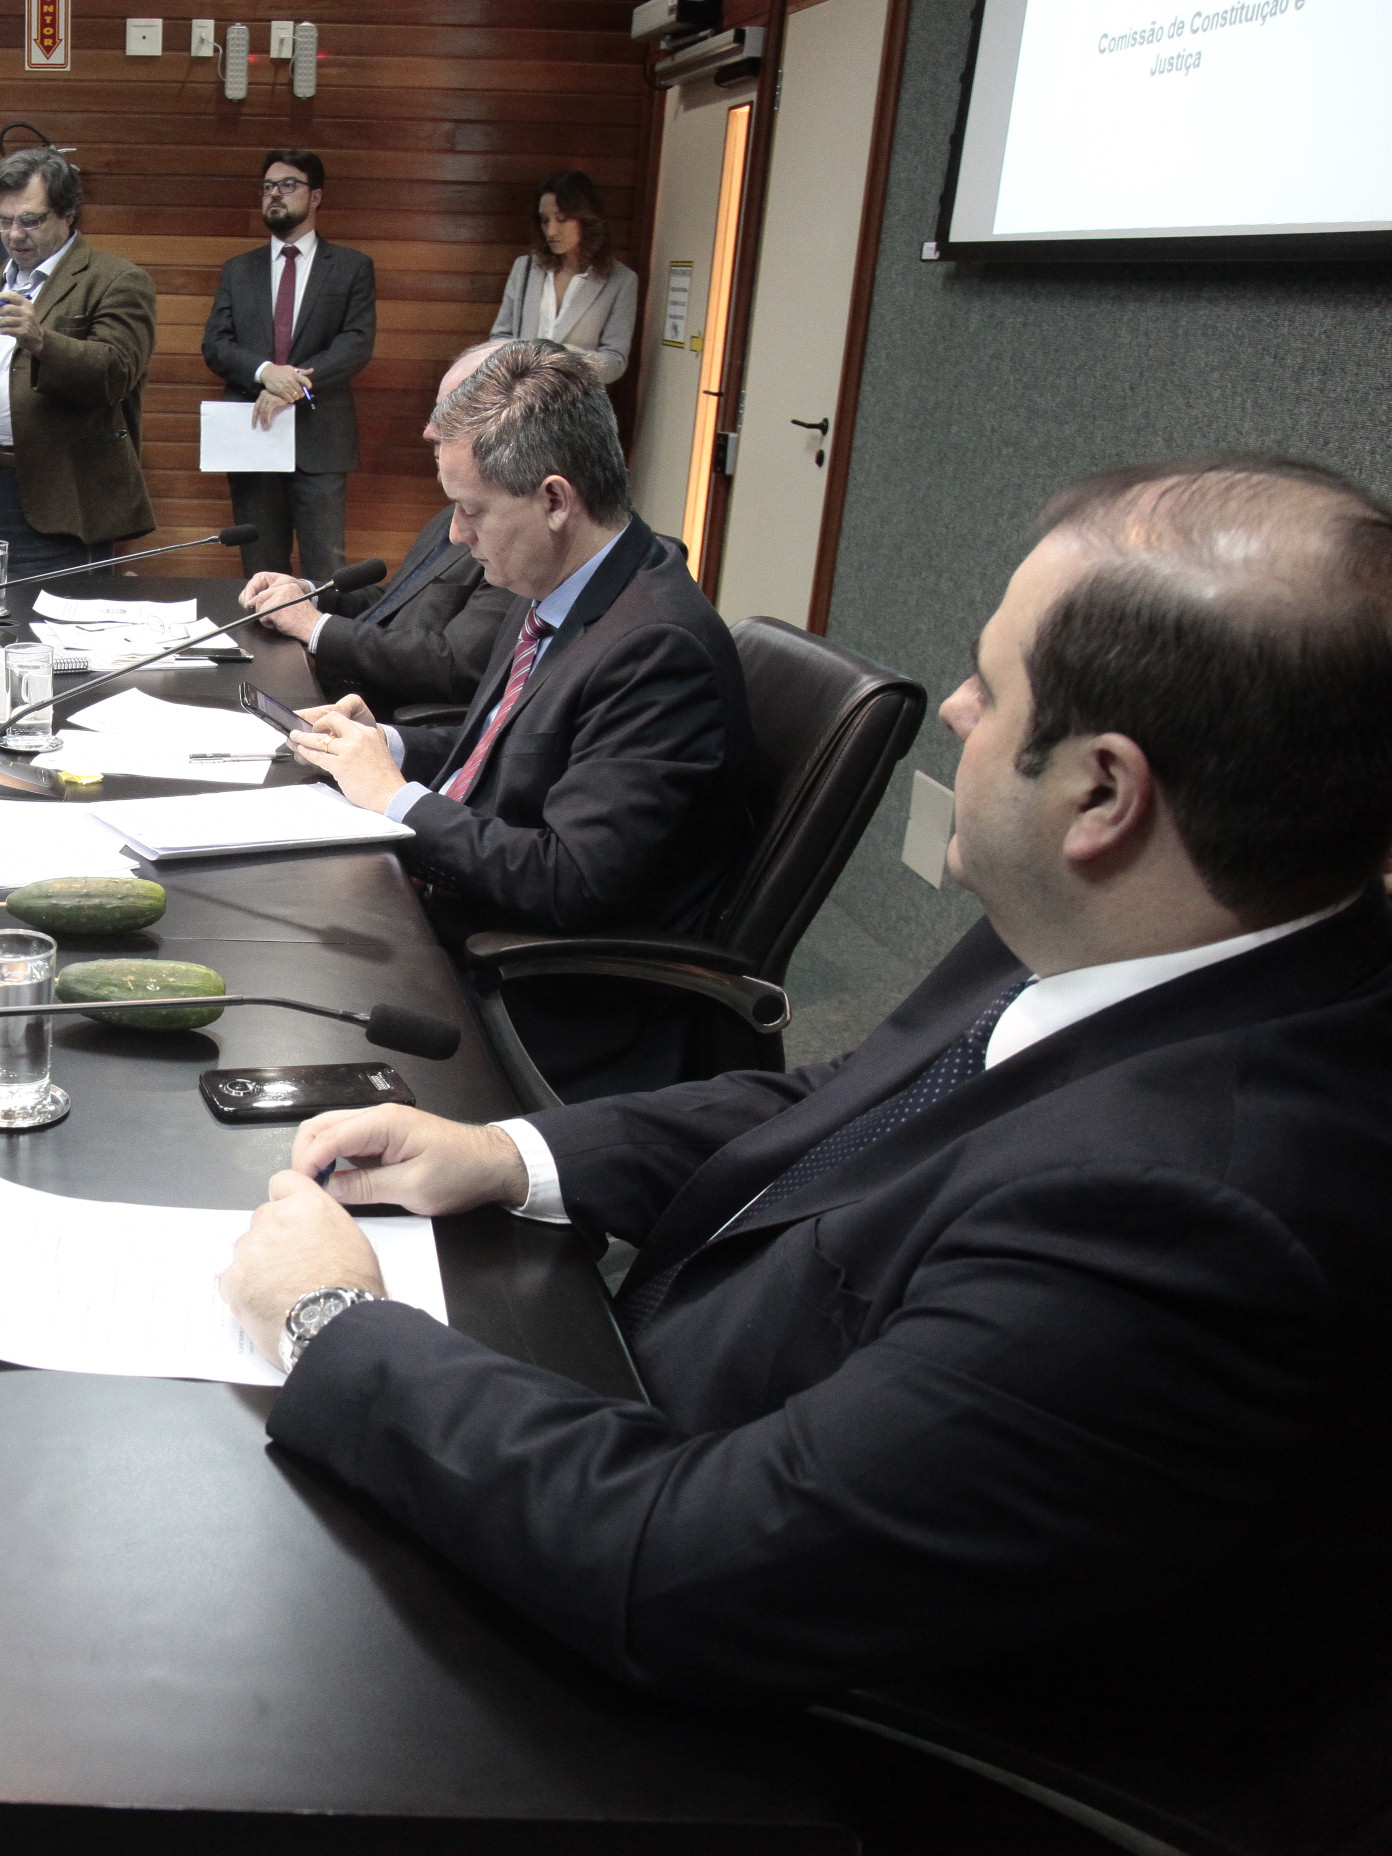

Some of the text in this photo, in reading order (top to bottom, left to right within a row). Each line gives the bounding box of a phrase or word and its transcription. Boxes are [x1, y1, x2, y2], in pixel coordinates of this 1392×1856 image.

[43, 0, 54, 46] NTOR
[1098, 21, 1164, 55] Comissão
[1167, 15, 1185, 40] de
[1189, 0, 1289, 35] Constituição
[1150, 48, 1203, 77] Justiça
